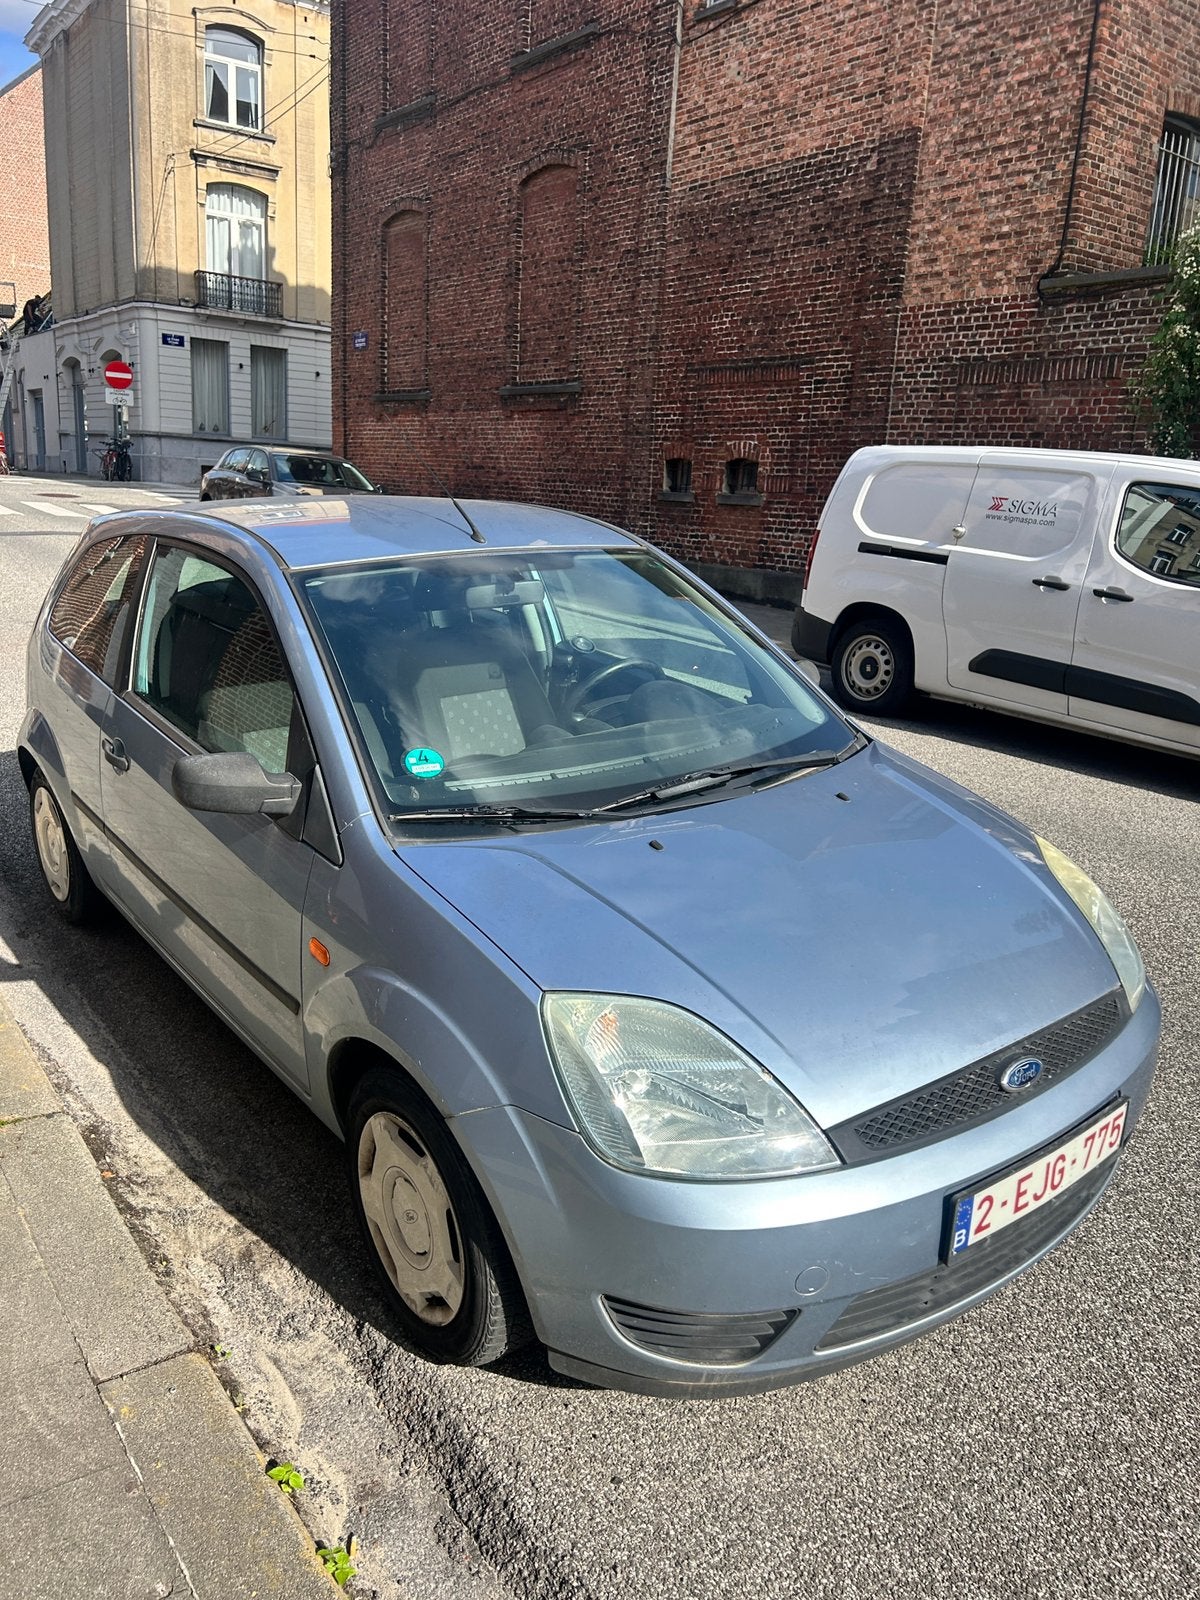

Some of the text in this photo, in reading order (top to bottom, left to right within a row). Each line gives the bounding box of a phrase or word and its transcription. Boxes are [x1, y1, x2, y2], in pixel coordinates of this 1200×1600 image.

[1008, 499, 1058, 518] SIGMA
[985, 513, 1056, 527] www.sigmaspa.com
[418, 750, 429, 763] 4
[1013, 1064, 1037, 1085] Ford
[973, 1111, 1124, 1236] 2-EJG-775
[953, 1228, 967, 1248] B
